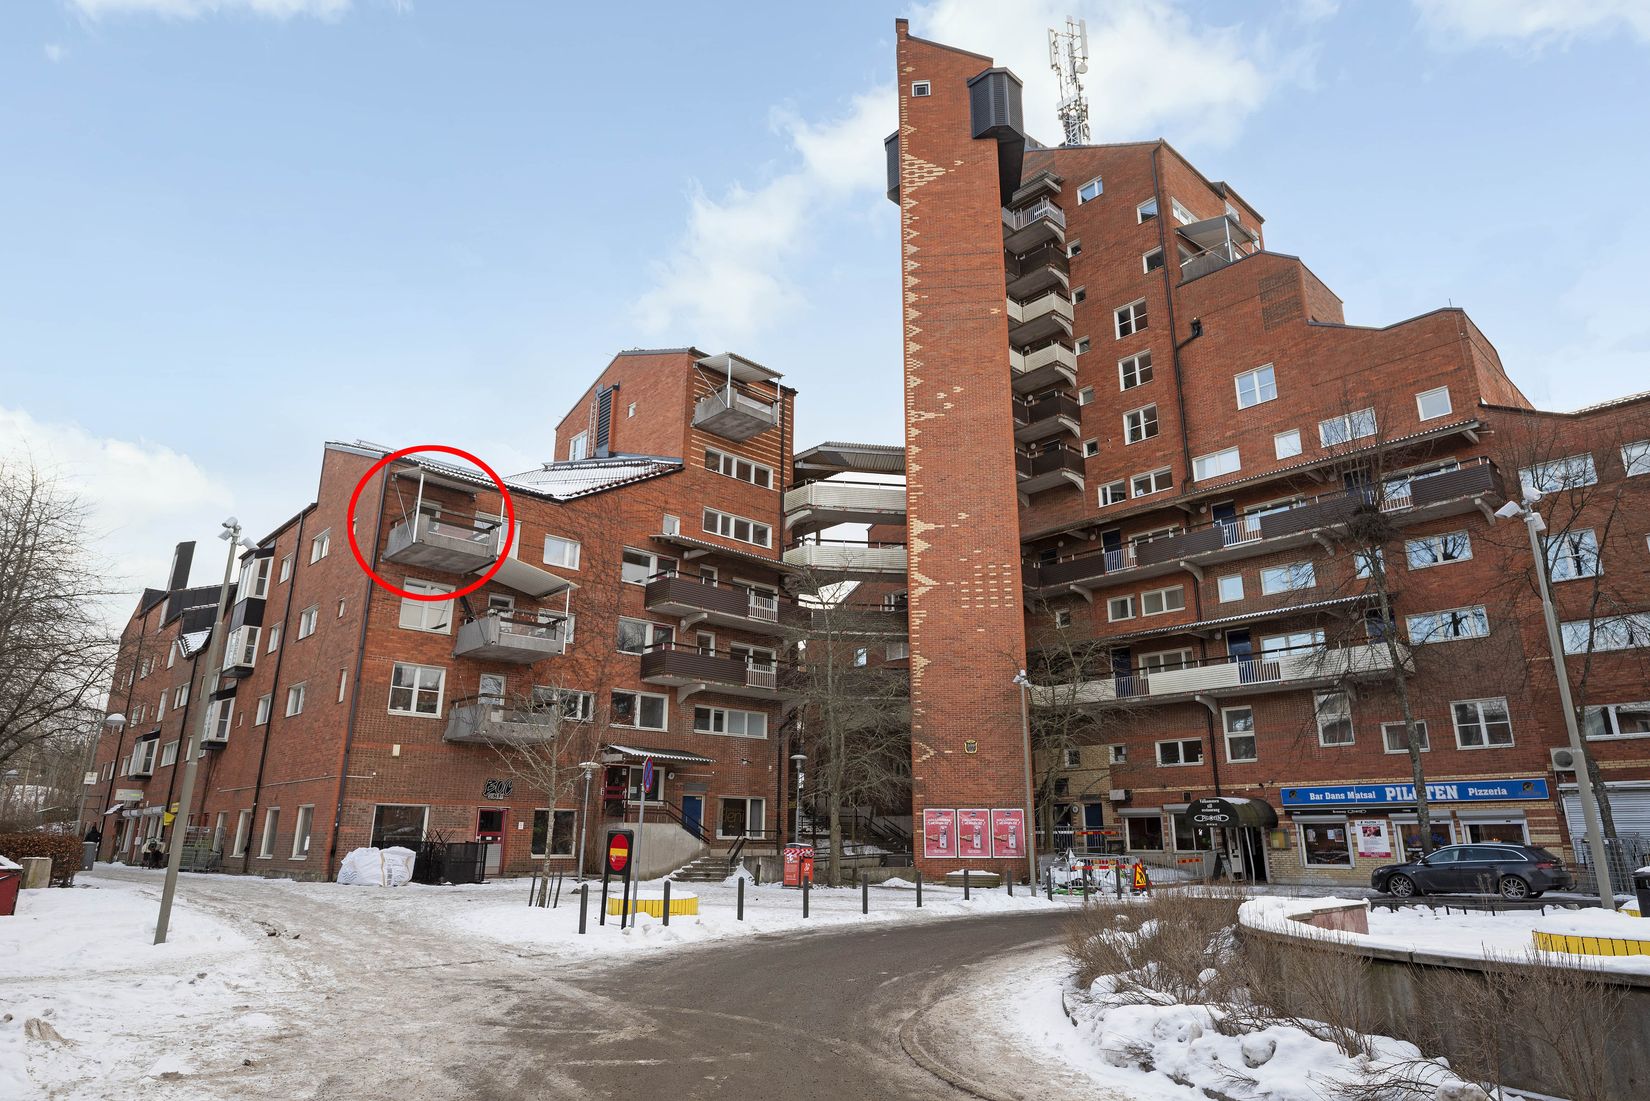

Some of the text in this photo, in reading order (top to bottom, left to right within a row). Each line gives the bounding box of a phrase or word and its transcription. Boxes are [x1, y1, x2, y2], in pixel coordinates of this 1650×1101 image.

[1309, 792, 1323, 800] Bar
[1325, 791, 1345, 800] Dans
[1347, 790, 1376, 800] Matsal
[1468, 787, 1507, 796] Pizzeria
